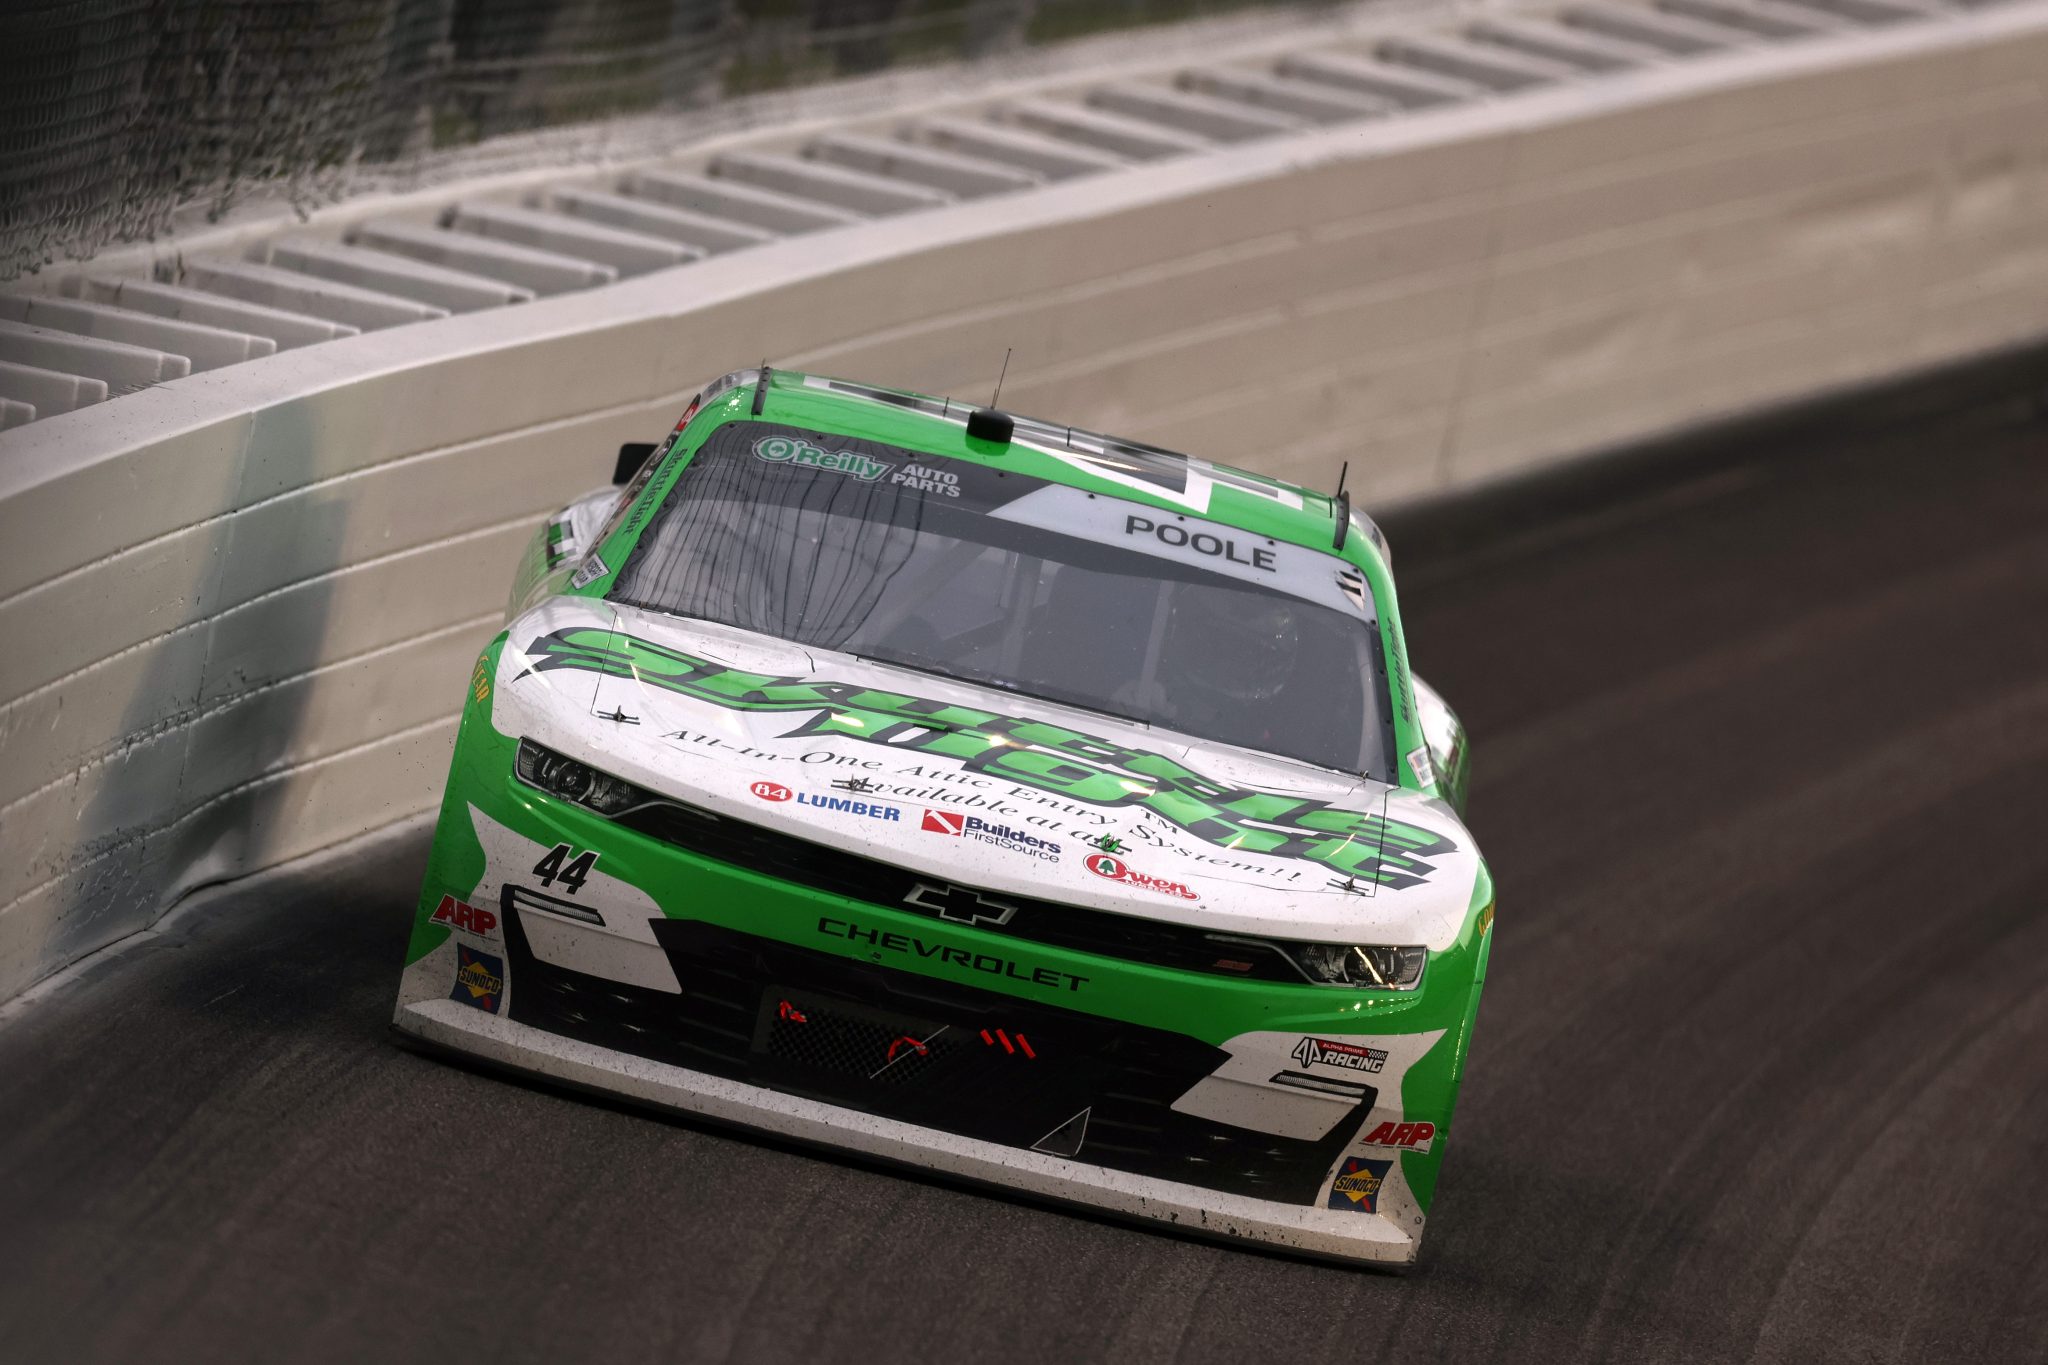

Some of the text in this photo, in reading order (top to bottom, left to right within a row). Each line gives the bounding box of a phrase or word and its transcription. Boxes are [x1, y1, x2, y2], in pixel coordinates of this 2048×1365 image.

[756, 436, 888, 480] O'Reilly
[901, 464, 959, 485] AUTO
[891, 472, 960, 498] PARTS
[1125, 515, 1277, 573] POOLE
[753, 783, 900, 822] 84 LUMBER
[896, 761, 992, 788] Attic
[1003, 786, 1117, 825] Entry
[1129, 825, 1301, 881] System!!
[966, 816, 1061, 854] Builders
[1026, 815, 1064, 831] at
[1141, 808, 1178, 834] TM
[964, 829, 1060, 864] FirstSource
[531, 844, 598, 895] 44
[1086, 854, 1198, 900] Owen
[432, 895, 497, 935] ARP
[818, 917, 1089, 991] CHEVROLET
[460, 967, 500, 993] SUNOCO
[1322, 1051, 1383, 1072] RACING
[1362, 1121, 1435, 1146] ARP
[1336, 1176, 1379, 1193] SUNOCO
